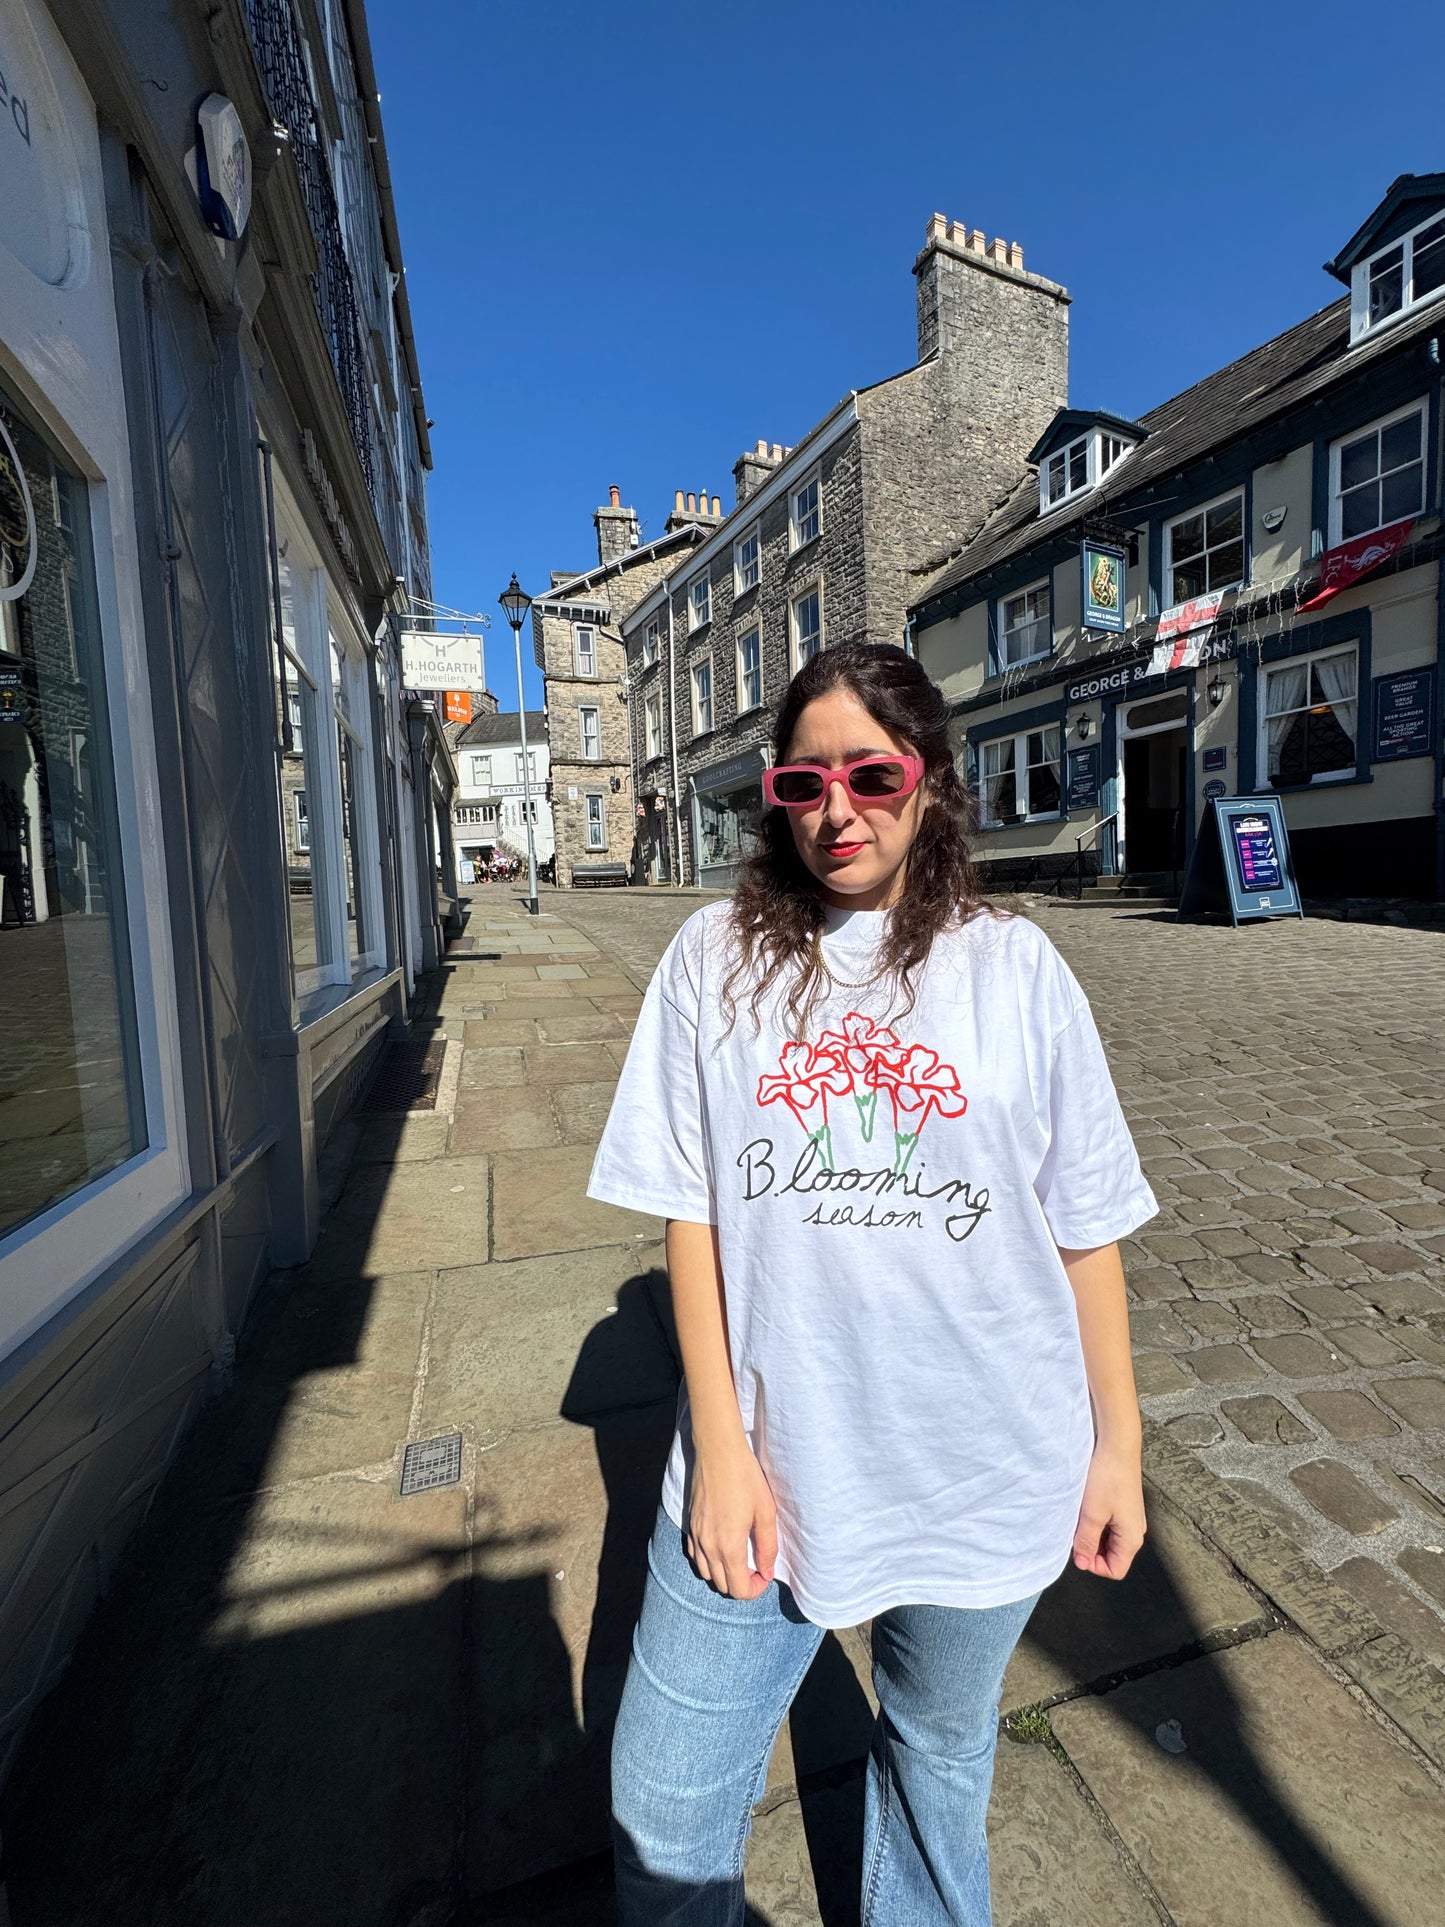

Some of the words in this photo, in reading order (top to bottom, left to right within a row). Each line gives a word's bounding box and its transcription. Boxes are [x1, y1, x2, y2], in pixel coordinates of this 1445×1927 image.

[435, 645, 446, 657] H
[405, 660, 477, 673] H.HOGARTH
[420, 673, 466, 683] Jewellers
[1070, 668, 1130, 699] GEORGE
[1133, 666, 1146, 681] &
[802, 1202, 923, 1228] season
